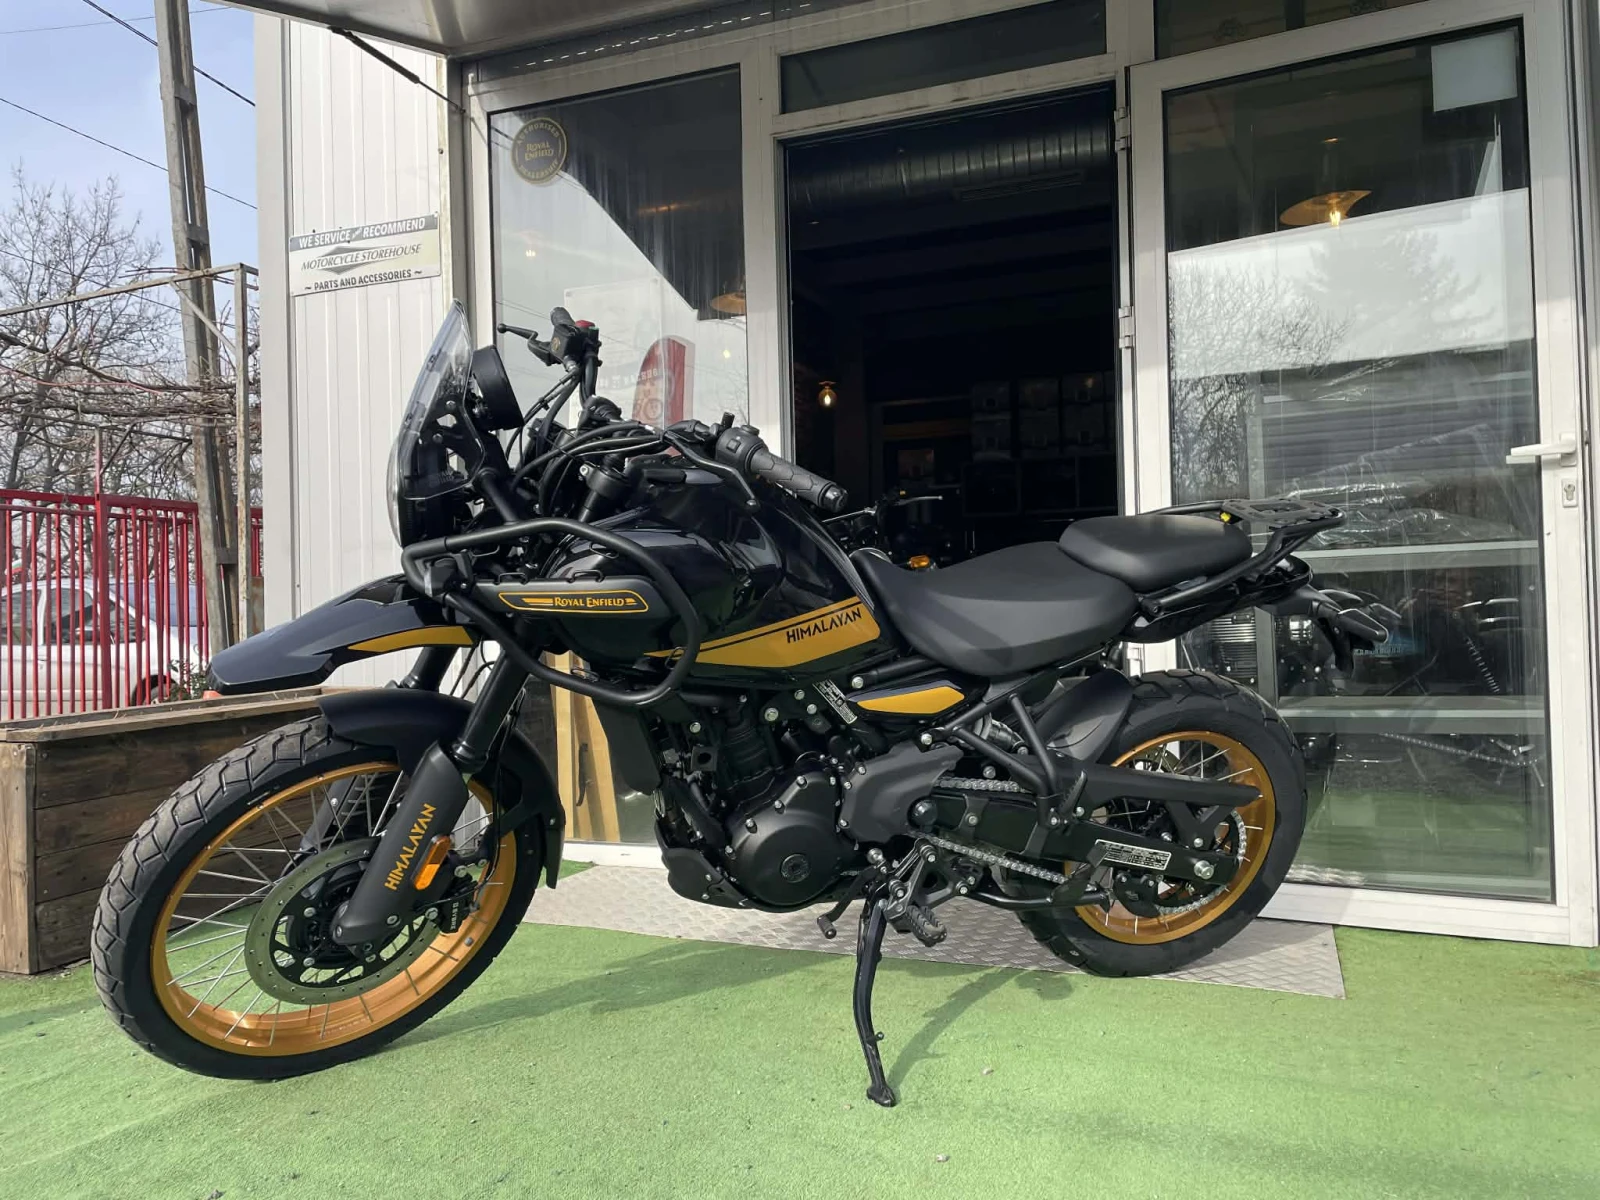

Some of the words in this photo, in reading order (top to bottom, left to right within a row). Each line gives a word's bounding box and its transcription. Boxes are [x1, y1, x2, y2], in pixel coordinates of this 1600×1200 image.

[300, 234, 313, 248] WE
[314, 230, 350, 246] SERVICE
[363, 218, 425, 238] RECOMMEND
[301, 252, 360, 271] MOTORCYCLE
[362, 243, 421, 261] STOREHOUSE
[314, 279, 338, 291] PARTS
[340, 276, 356, 288] AND
[358, 269, 412, 285] ACCESSORIES
[786, 607, 862, 644] HIMALAYAN
[384, 803, 436, 890] HIMALAYAN
